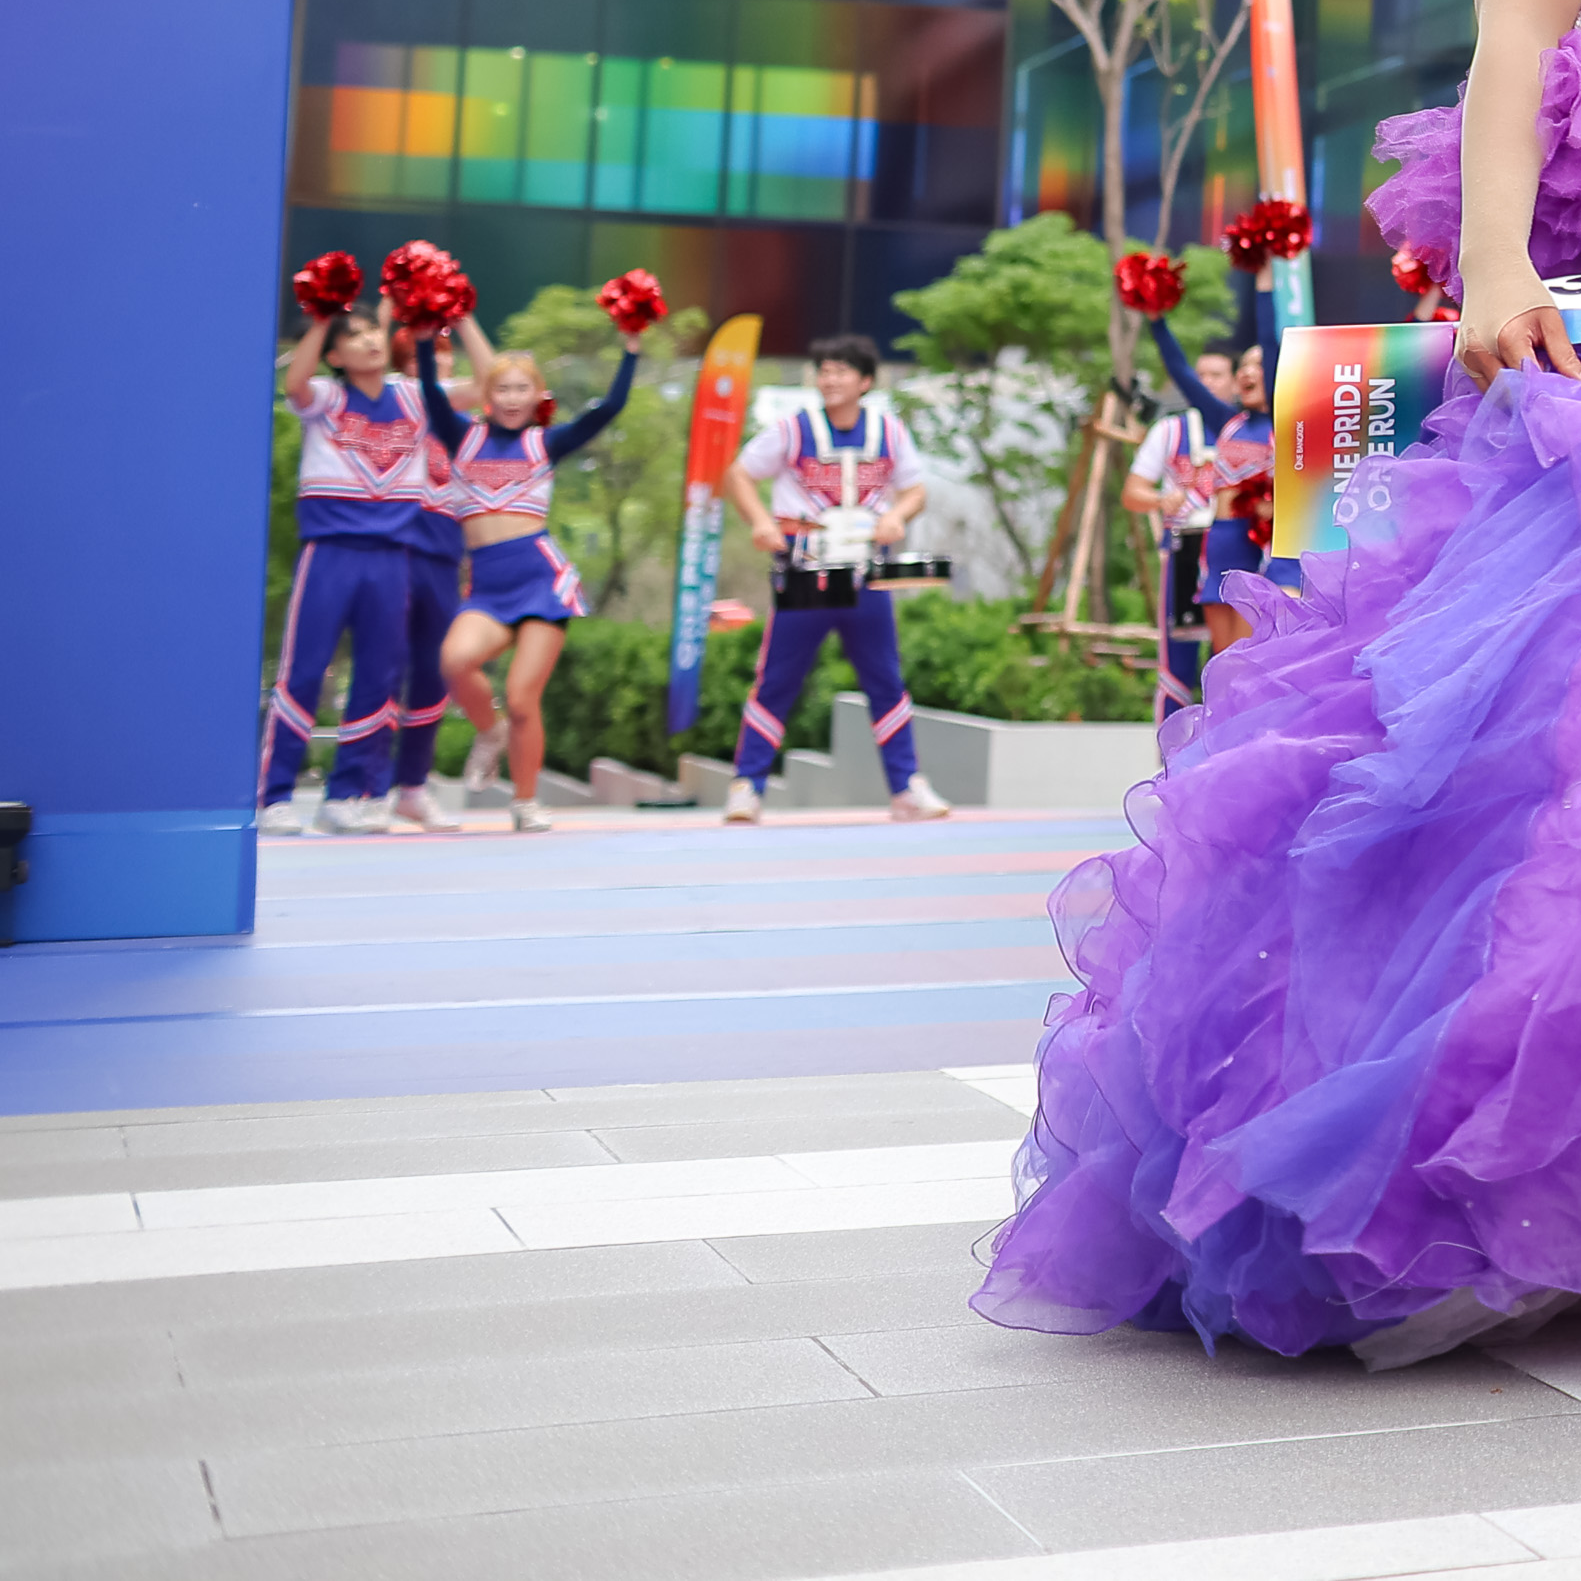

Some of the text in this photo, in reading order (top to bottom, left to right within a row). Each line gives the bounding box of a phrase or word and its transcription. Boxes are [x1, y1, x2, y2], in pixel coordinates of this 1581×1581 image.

[1332, 363, 1362, 523] ONE PRIDE
[1368, 378, 1396, 437] RUN
